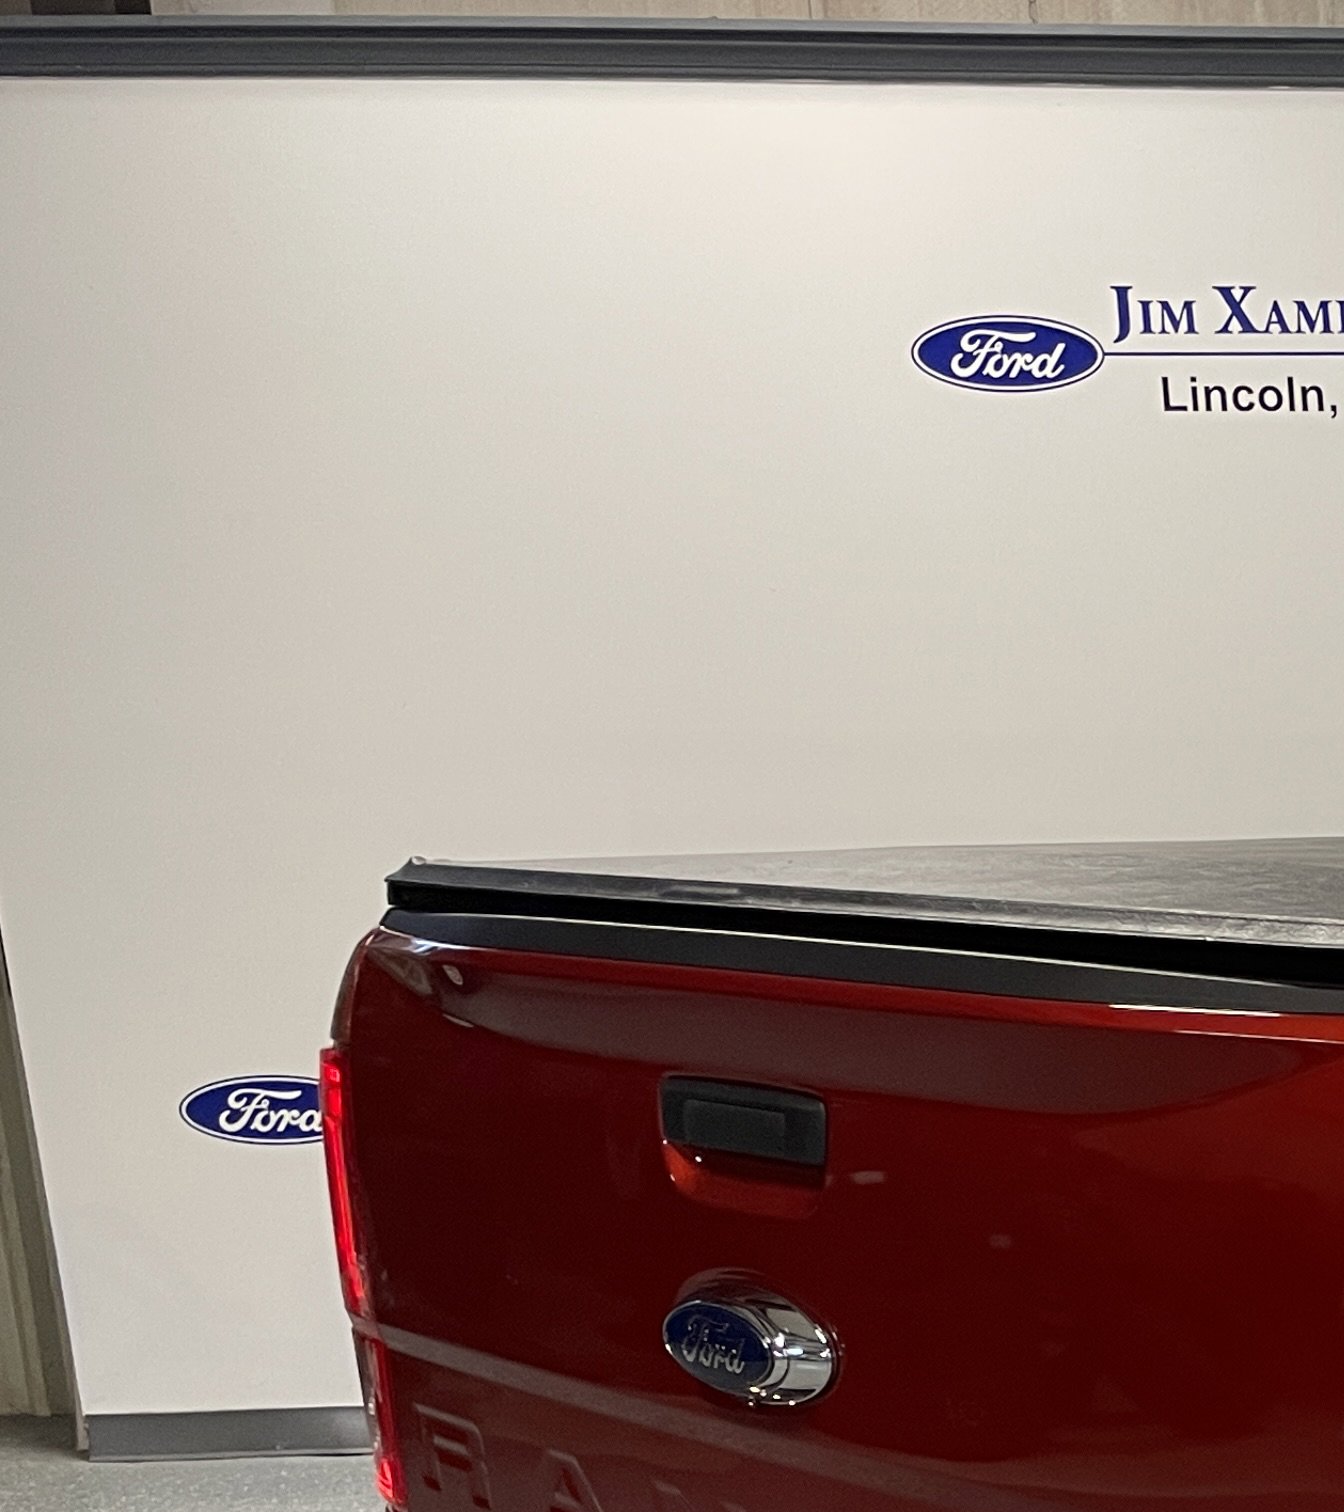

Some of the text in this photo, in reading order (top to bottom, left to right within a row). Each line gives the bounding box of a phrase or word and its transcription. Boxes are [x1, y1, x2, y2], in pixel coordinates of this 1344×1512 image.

[1110, 285, 1199, 343] JIM
[950, 329, 1066, 378] Ford
[1161, 376, 1338, 419] Lincoln,
[682, 1314, 746, 1374] Ford
